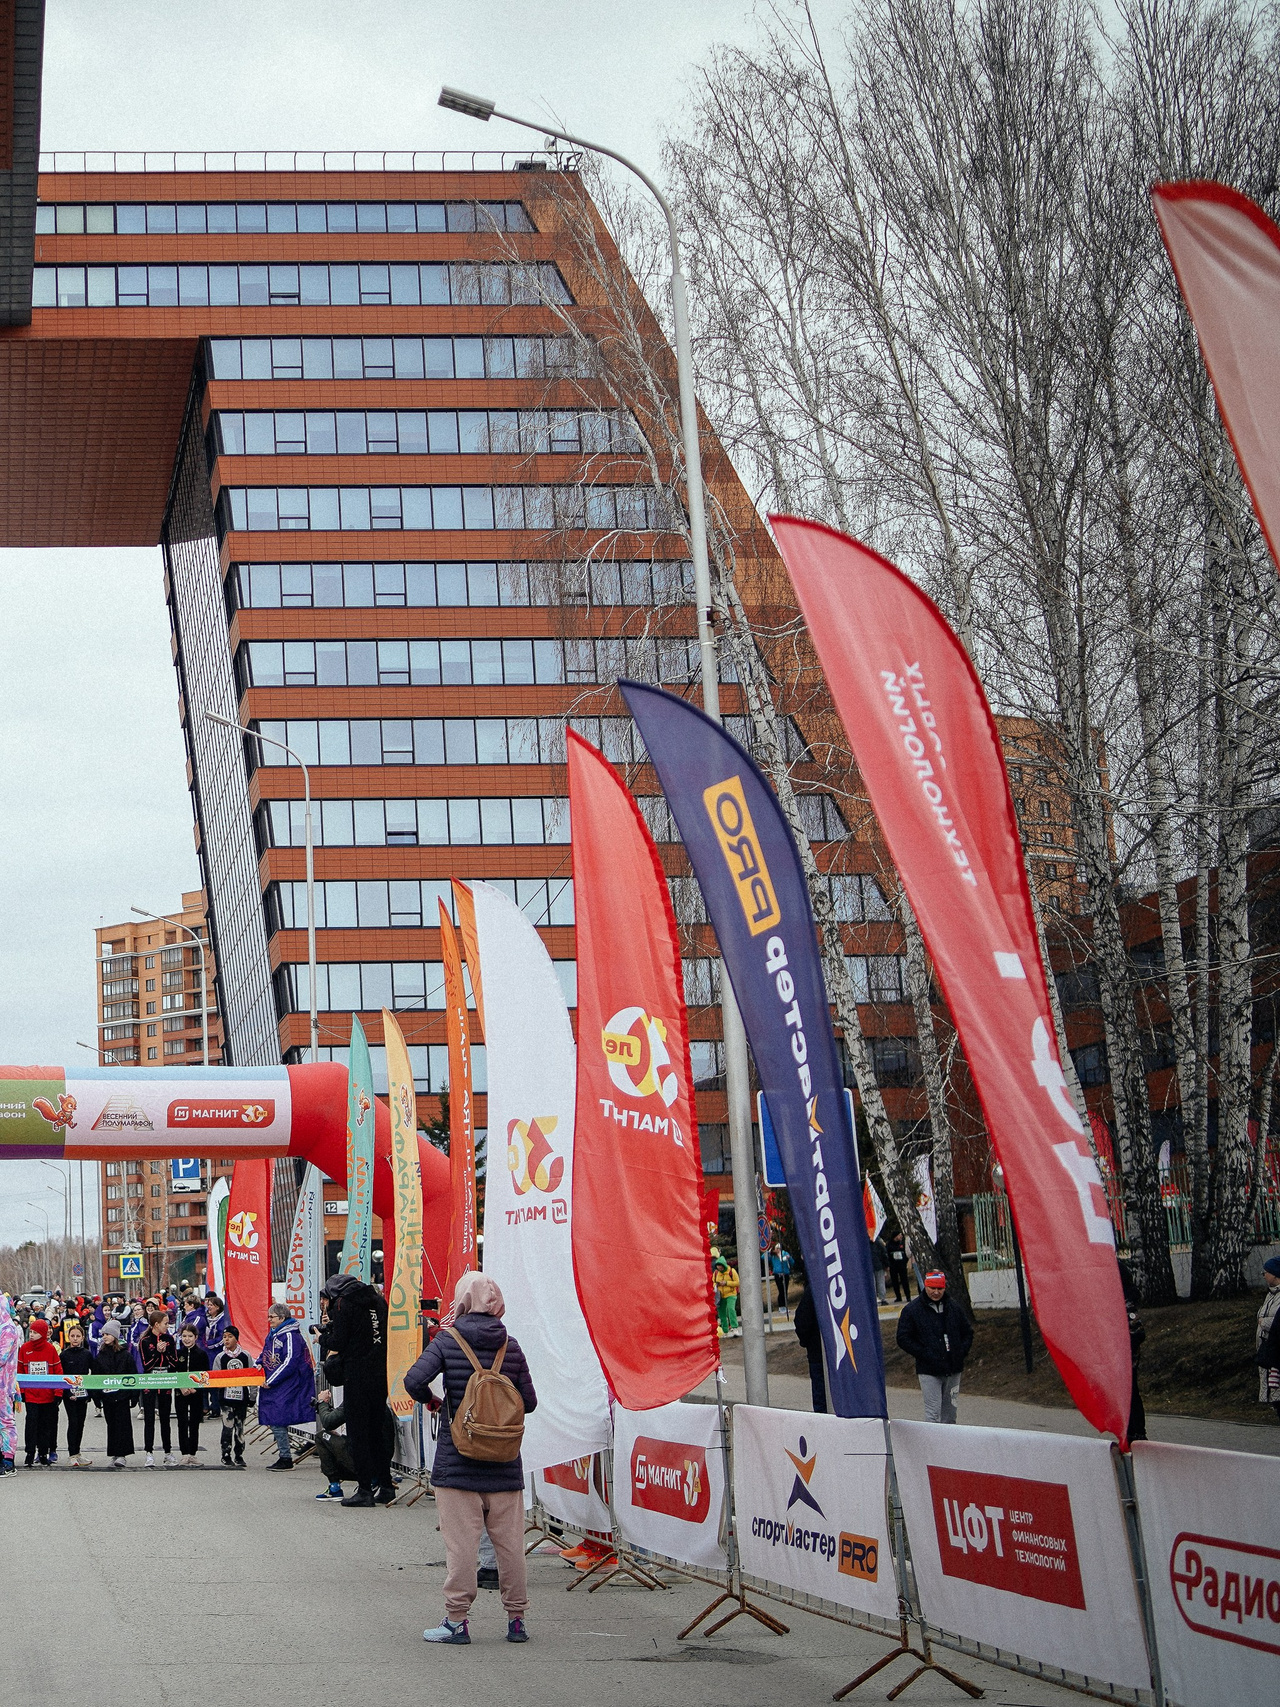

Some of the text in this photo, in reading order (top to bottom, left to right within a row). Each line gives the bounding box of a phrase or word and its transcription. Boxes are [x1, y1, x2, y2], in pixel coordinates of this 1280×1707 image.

[102, 1112, 138, 1120] ВЕСЕННИЙ
[192, 1109, 239, 1118] МАГНИТ
[648, 1465, 682, 1492] МАГНИТ
[943, 1497, 1005, 1558] ЦФТ
[1008, 1509, 1034, 1525] ЦЕНТР
[1011, 1529, 1068, 1553] ФИНАНСОВЫХ
[840, 1538, 878, 1575] PRO
[1014, 1549, 1067, 1573] ТЕХНОЛОГИЙ
